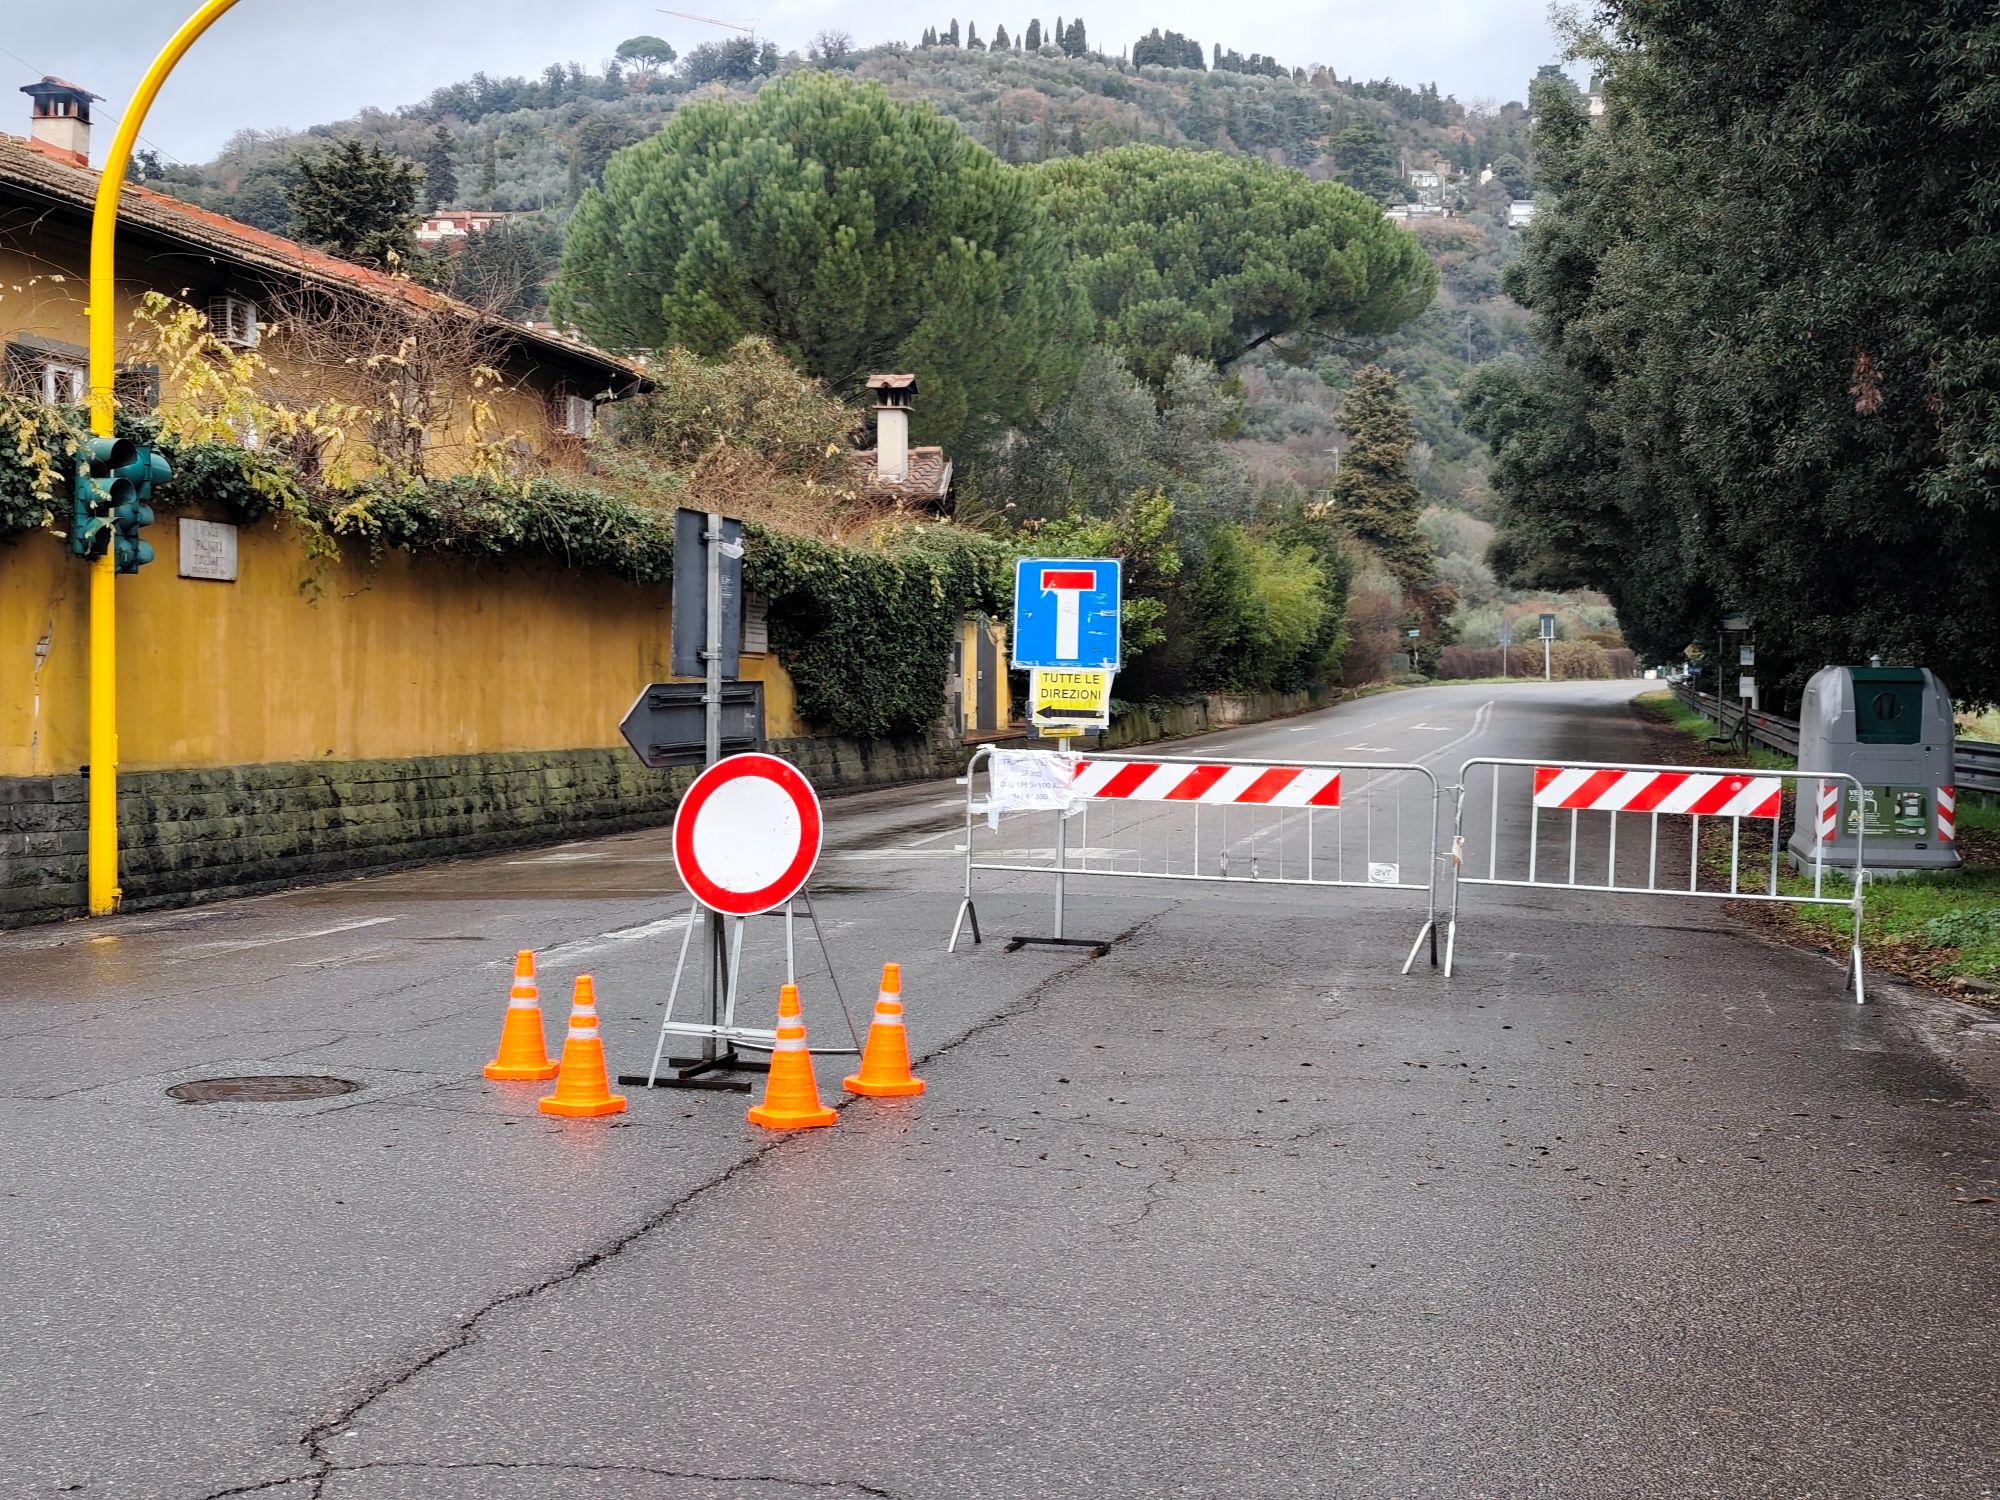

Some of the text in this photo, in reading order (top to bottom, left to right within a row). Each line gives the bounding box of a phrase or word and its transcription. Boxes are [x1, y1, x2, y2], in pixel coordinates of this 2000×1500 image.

[1043, 673, 1100, 685] TUTTE LE
[1041, 688, 1101, 700] DIREZIONI
